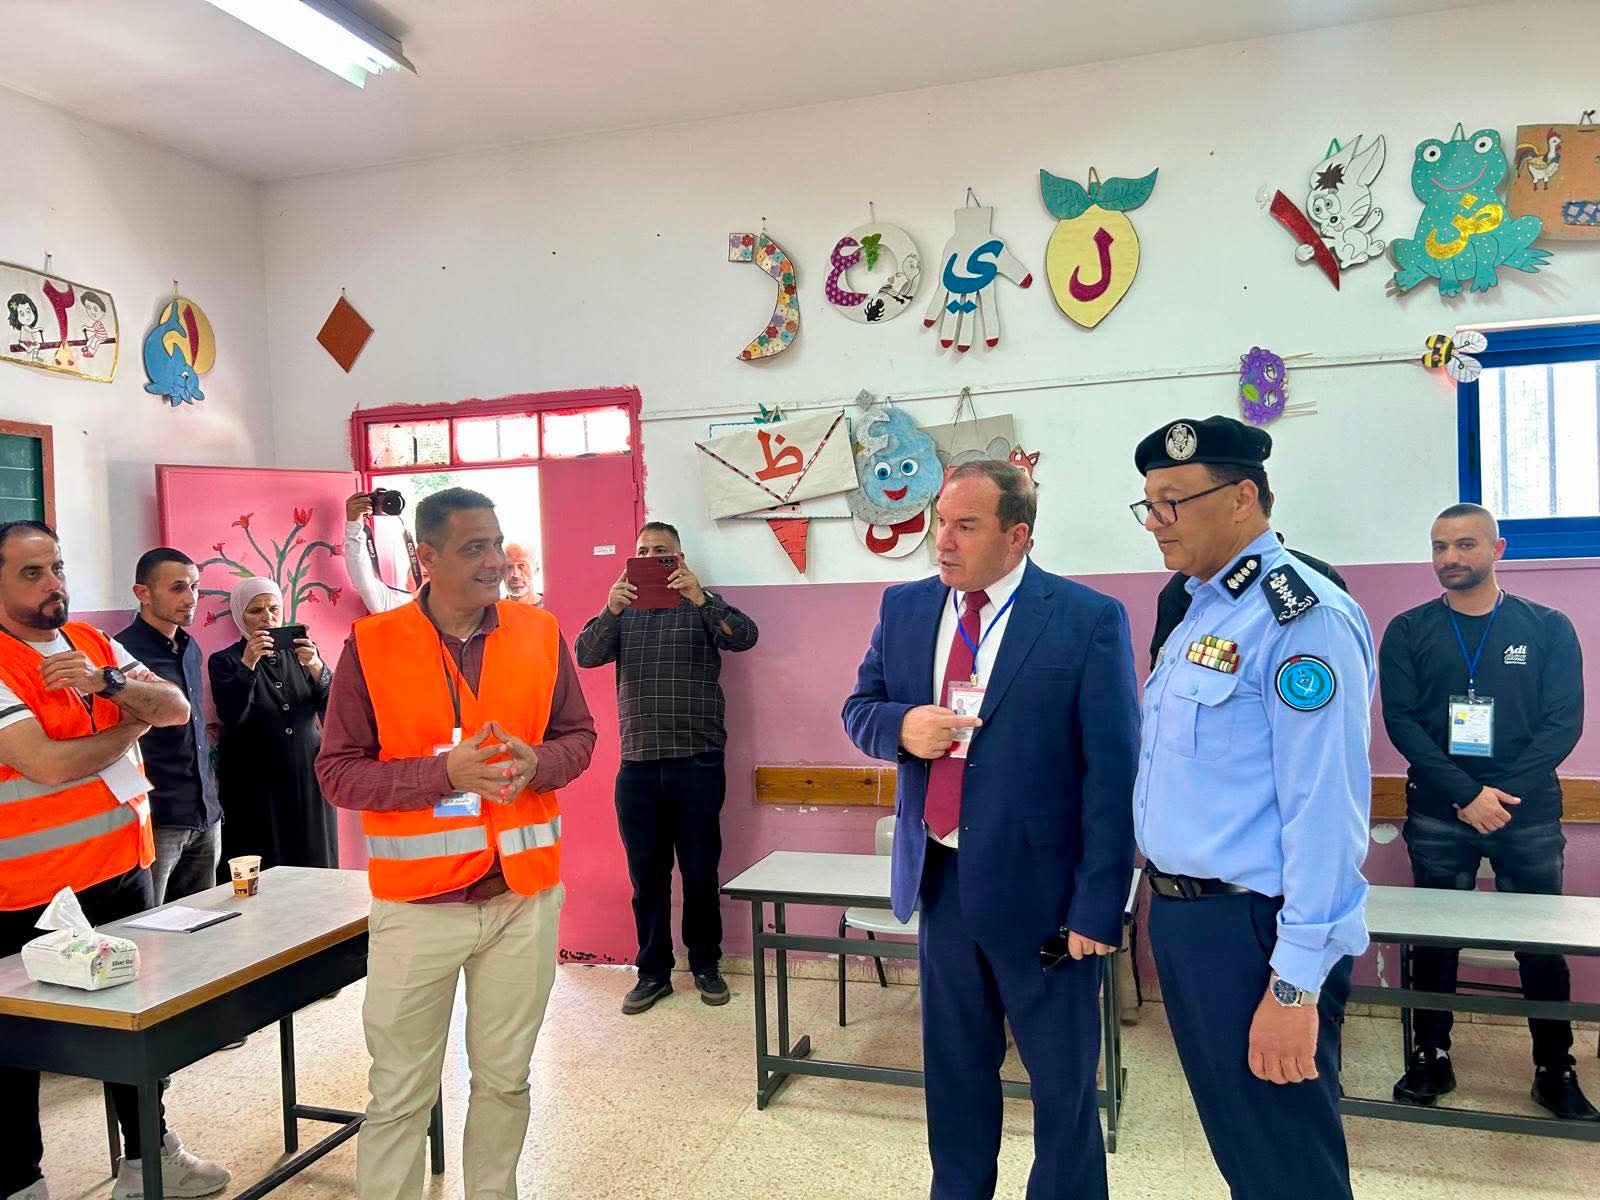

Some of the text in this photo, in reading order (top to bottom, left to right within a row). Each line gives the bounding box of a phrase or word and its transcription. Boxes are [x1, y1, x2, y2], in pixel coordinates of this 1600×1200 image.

[825, 236, 869, 307] ع
[943, 240, 1004, 314] ي
[1069, 227, 1114, 301] ل
[755, 429, 804, 481] ظ
[1504, 644, 1527, 654] Adi
